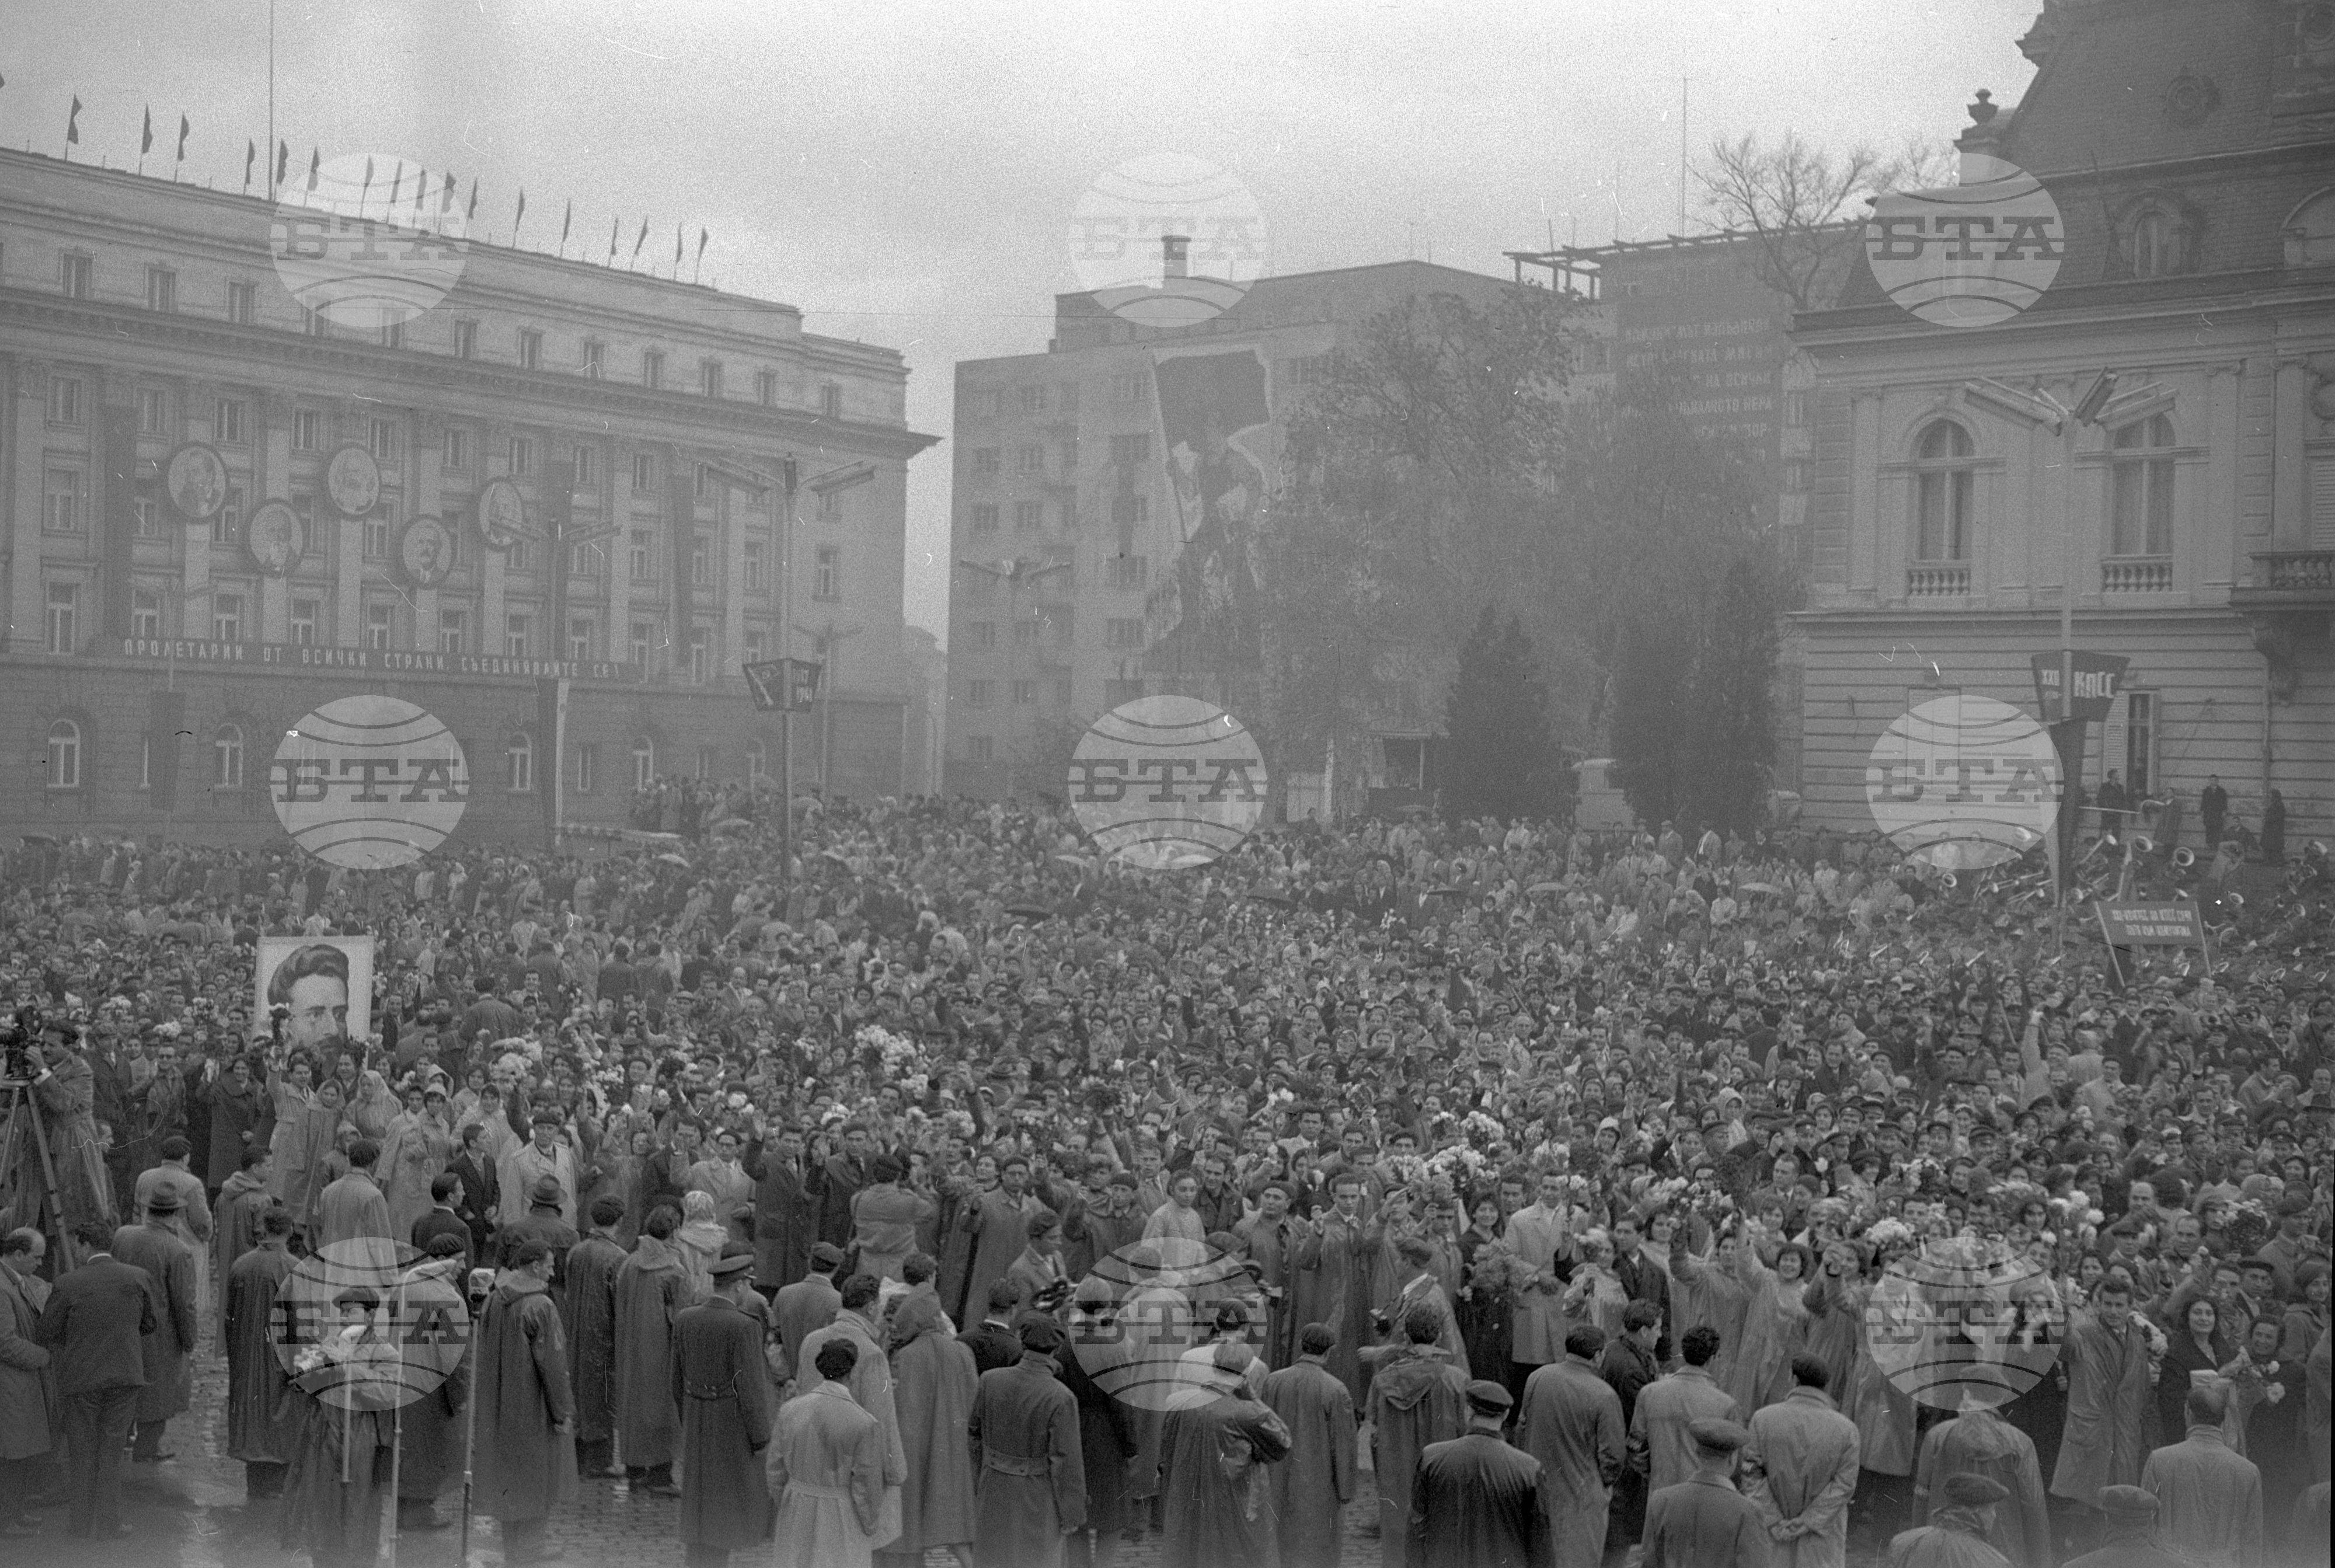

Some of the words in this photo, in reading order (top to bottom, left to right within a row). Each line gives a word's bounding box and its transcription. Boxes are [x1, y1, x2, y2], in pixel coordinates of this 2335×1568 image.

[124, 639, 243, 661] ПРОЛЕТАРИИ
[263, 647, 281, 663] ОТ
[302, 649, 367, 666] ВСИЧКИ
[2073, 671, 2115, 699] КПСС
